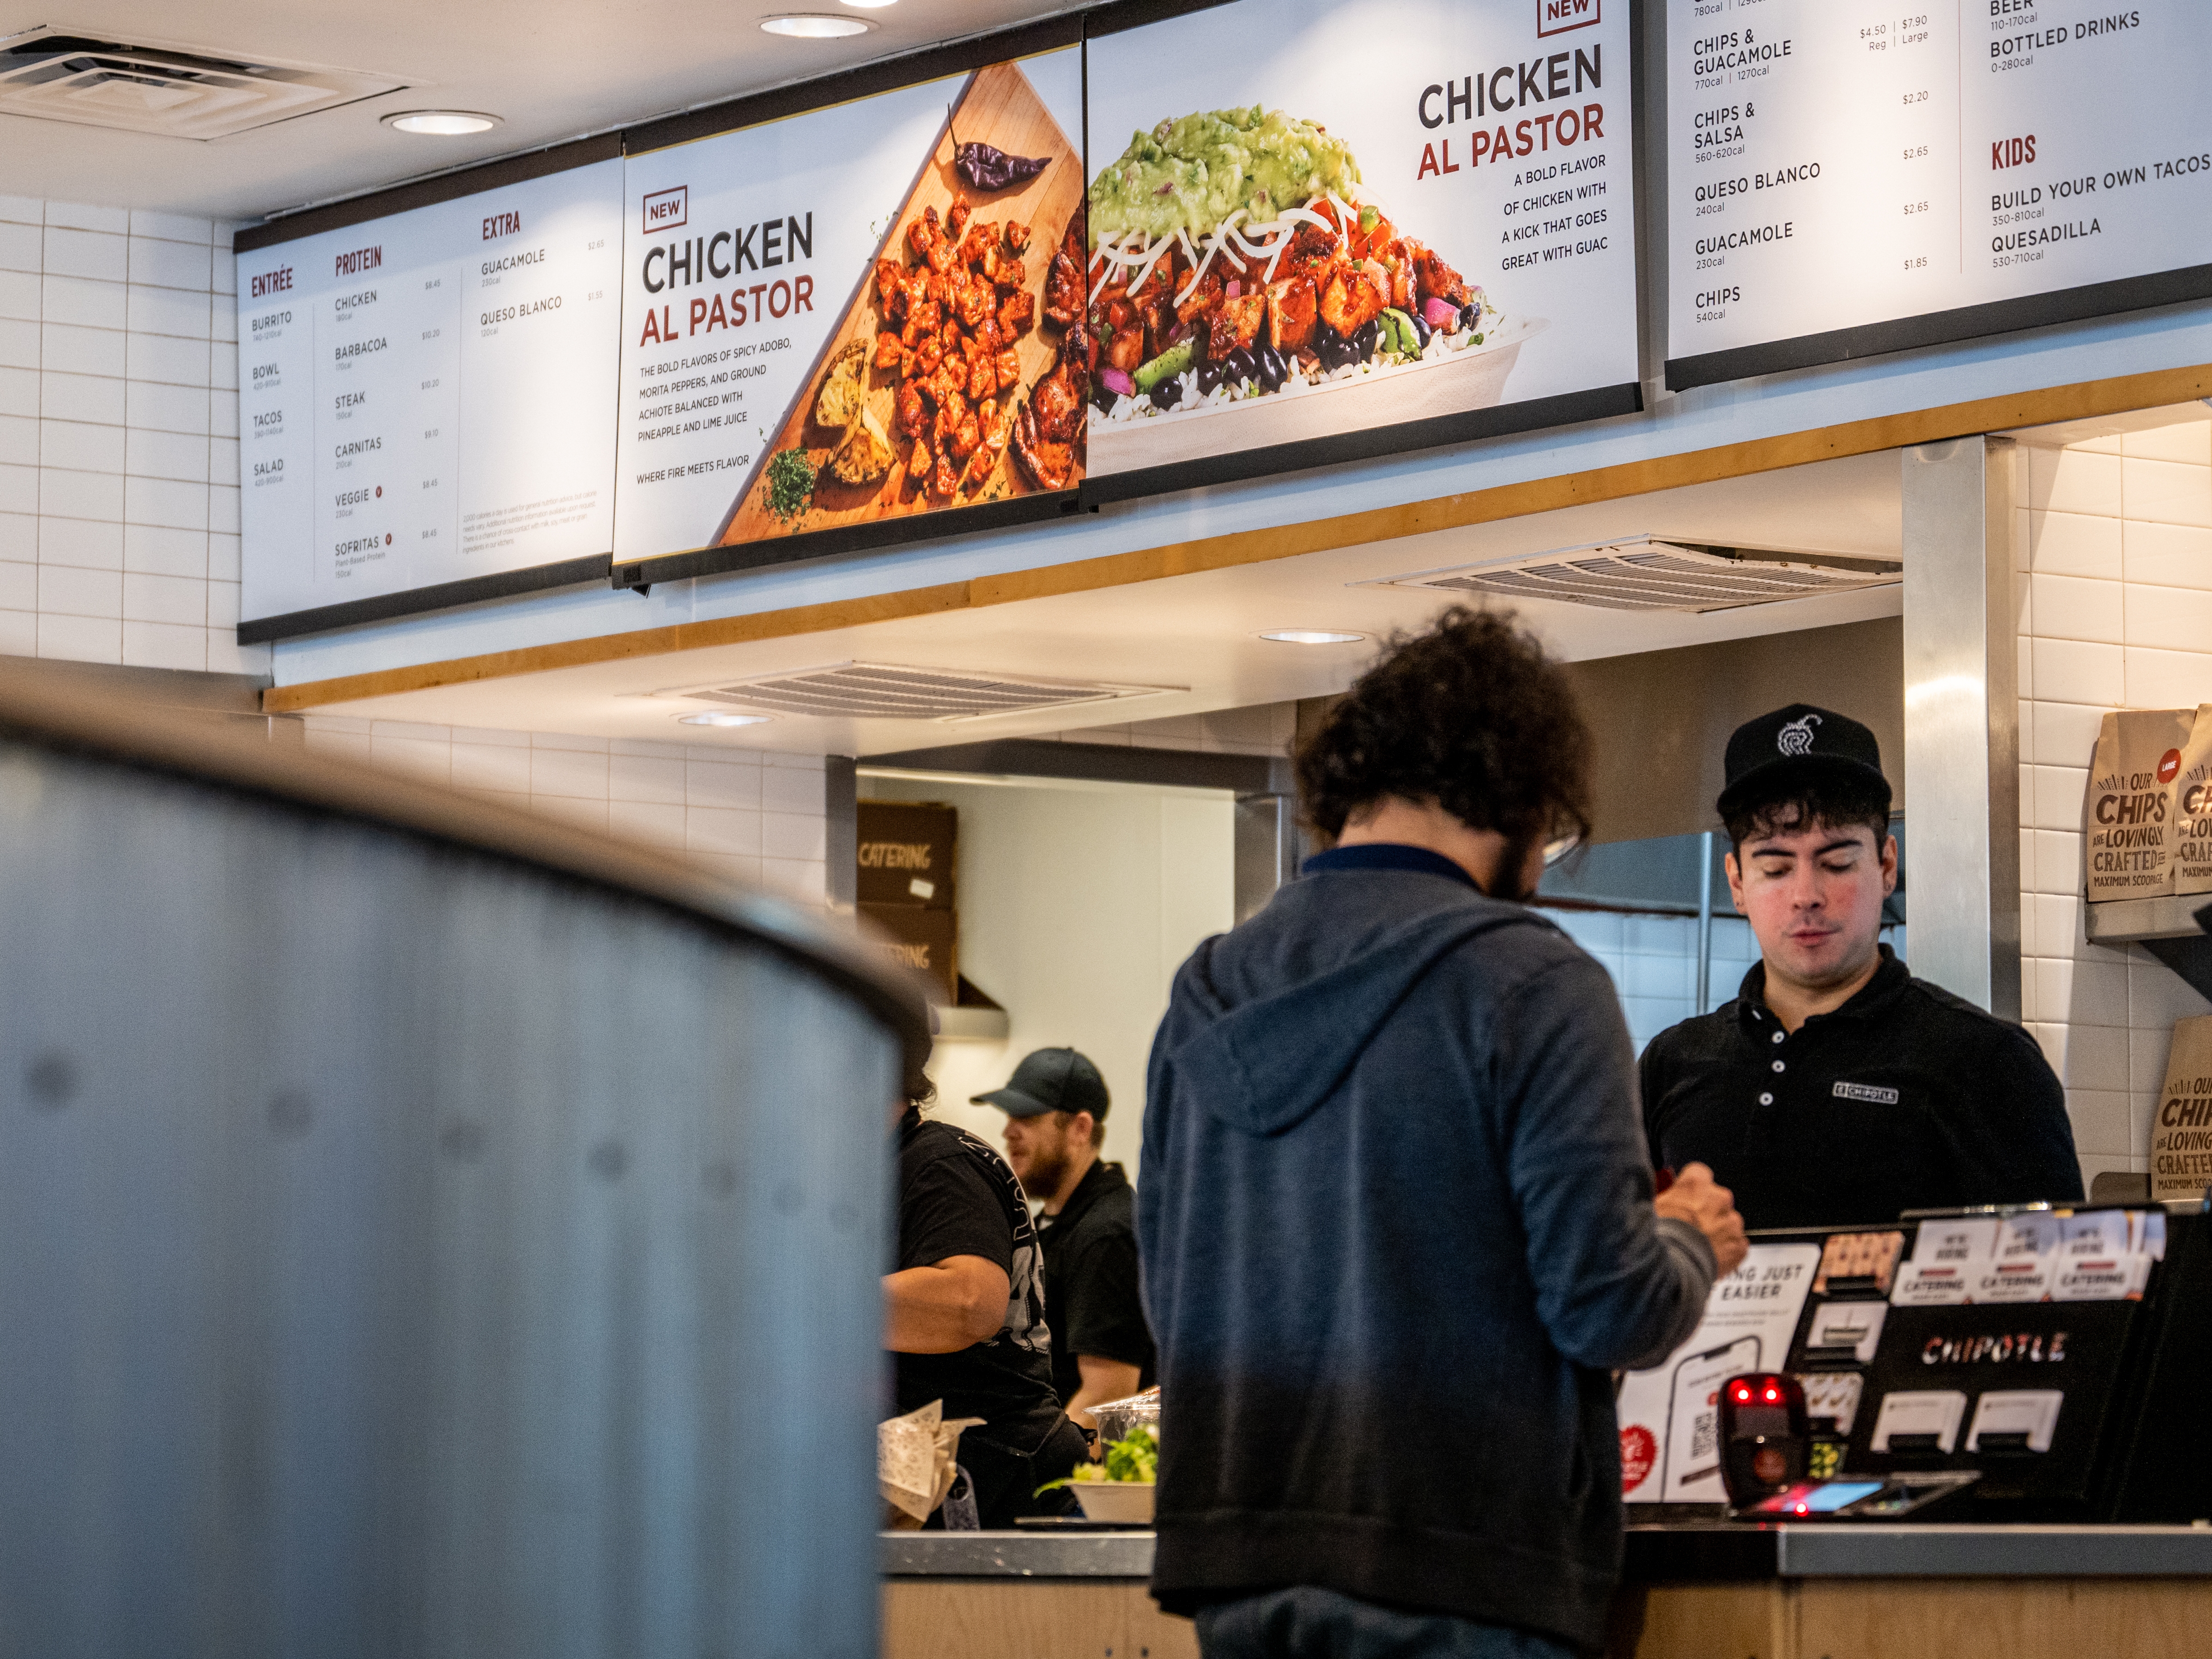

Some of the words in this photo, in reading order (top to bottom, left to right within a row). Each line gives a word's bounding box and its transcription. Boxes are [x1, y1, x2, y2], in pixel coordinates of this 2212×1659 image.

[1548, 0, 1589, 20] NEW
[1694, 2, 1722, 17] 780cal
[1991, 0, 2034, 16] BEER
[1903, 15, 1927, 30] $7.90
[1991, 12, 2037, 30] 110-170cal
[1860, 24, 1886, 39] $4.50
[1903, 32, 1928, 43] Large
[1991, 27, 2067, 57] BOTTLED
[2075, 11, 2140, 39] DRINKS
[1694, 32, 1738, 55] CHIPS
[1745, 29, 1754, 44] &
[1869, 41, 1886, 51] Reg
[1694, 40, 1791, 75] GUACAMOLE
[1991, 55, 2033, 73] 0-280cal
[1737, 65, 1769, 80] 1270cal
[1418, 43, 1601, 129] CHICKEN
[1695, 75, 1722, 90] 770cal
[1903, 91, 1928, 105] $2.20
[1694, 105, 1739, 128] CHIPS
[1745, 102, 1755, 118] &
[1417, 139, 1460, 181] AL
[1472, 103, 1605, 168] PASTOR
[1695, 125, 1744, 149] SALSA
[1696, 144, 1745, 163] 560-620cal
[1903, 146, 1928, 160] $2.65
[1992, 134, 2036, 170] KIDS
[1514, 174, 1522, 187] A
[1526, 166, 1557, 184] BOLD
[1561, 154, 1606, 176] FLAVOR
[1695, 177, 1748, 202] QUESO
[1755, 163, 1820, 190] BLANCO
[1992, 187, 2041, 211] BUILD
[2048, 176, 2096, 199] YOUR
[2103, 166, 2145, 189] OWN
[2153, 153, 2211, 179] TACOS
[1504, 201, 1519, 216] OF
[1523, 189, 1573, 211] CHICKEN
[1576, 182, 1606, 199] WITH
[1904, 201, 1928, 215] $2.65
[650, 199, 680, 221] NEW
[1696, 202, 1724, 217] 240cal
[1992, 207, 2044, 226] 350-810cal
[483, 211, 520, 240] EXTRA
[1502, 231, 1510, 244] A
[1514, 224, 1539, 241] KICK
[1543, 217, 1572, 234] THAT
[1576, 209, 1607, 227] GOES
[588, 239, 604, 250] $2.65
[1696, 222, 1793, 255] GUACAMOLE
[1992, 218, 2102, 253] QUESADILLA
[336, 245, 382, 277] PROTEIN
[482, 249, 545, 275] GUACAMOLE
[642, 211, 812, 294] CHICKEN
[1502, 251, 1539, 270] GREAT
[1543, 244, 1572, 262] WITH
[1576, 236, 1608, 254] GUAC
[1993, 249, 2044, 268] 530-710cal
[1696, 255, 1725, 270] 230cal
[1904, 257, 1927, 270] $1.85
[252, 263, 293, 298] ENTRÉE
[425, 279, 441, 290] $8.45
[482, 276, 501, 287] 230cal
[335, 290, 377, 310] CHICKEN
[588, 291, 602, 301] $1.55
[1696, 286, 1740, 309] CHIPS
[481, 307, 515, 325] QUESO
[520, 296, 562, 316] BLANCO
[639, 305, 679, 348] AL
[690, 274, 814, 336] PASTOR
[1696, 309, 1725, 323] 540cal
[252, 311, 291, 331] BURRITO
[422, 329, 440, 340] $10.20
[481, 327, 498, 337] 120cal
[335, 337, 387, 360] BARBACOA
[640, 365, 655, 378] THE
[657, 361, 679, 374] BOLD
[681, 352, 717, 369] FLAVORS
[720, 350, 731, 361] OF
[733, 345, 757, 358] SPICY
[759, 338, 792, 353] ADOBO,
[253, 363, 279, 380] BOWL
[421, 379, 439, 390] $10.20
[639, 385, 668, 399] MORITA
[672, 376, 708, 393] PEPPERS,
[710, 372, 728, 385] AND
[730, 364, 766, 381] GROUND
[335, 391, 365, 409] STEAK
[638, 405, 673, 421] ACHIOTE
[675, 395, 719, 413] BALANCED
[721, 391, 743, 404] WITH
[254, 410, 282, 428] TACOS
[638, 424, 680, 442] PINEAPPLE
[683, 421, 700, 433] AND
[703, 417, 721, 429] LIME
[724, 412, 747, 425] JUICE
[424, 429, 438, 439] $9.10
[335, 437, 381, 458] CARNITAS
[254, 459, 283, 476] SALAD
[636, 470, 666, 485] WHERE
[668, 466, 685, 479] FIRE
[687, 461, 714, 475] MEETS
[716, 454, 749, 470] FLAVOR
[423, 478, 437, 489] $8.45
[335, 489, 369, 506] VEGGIE
[422, 528, 437, 539] $8.45
[335, 536, 379, 556] SOFRITAS
[335, 556, 365, 567] Plant-Based
[367, 551, 386, 561] Protein
[2162, 761, 2176, 771] LARGE
[2130, 773, 2153, 791] OUR
[2096, 792, 2168, 825] CHIPS
[2093, 834, 2104, 848] ARE
[2106, 826, 2164, 848] LOVINGLY
[2178, 824, 2189, 837] ARE
[857, 842, 931, 869] CATERING
[2094, 850, 2157, 872] CRAFTED
[2094, 875, 2130, 887] MAXIMUM
[2133, 873, 2163, 886] SCOOPAGE
[2157, 1137, 2166, 1150] ARE
[2158, 1179, 2193, 1190] MAXIMUM
[1762, 1264, 1803, 1281] JUST
[1721, 1283, 1781, 1301] EASIER
[1921, 1332, 2068, 1364] CHIPOTLE
